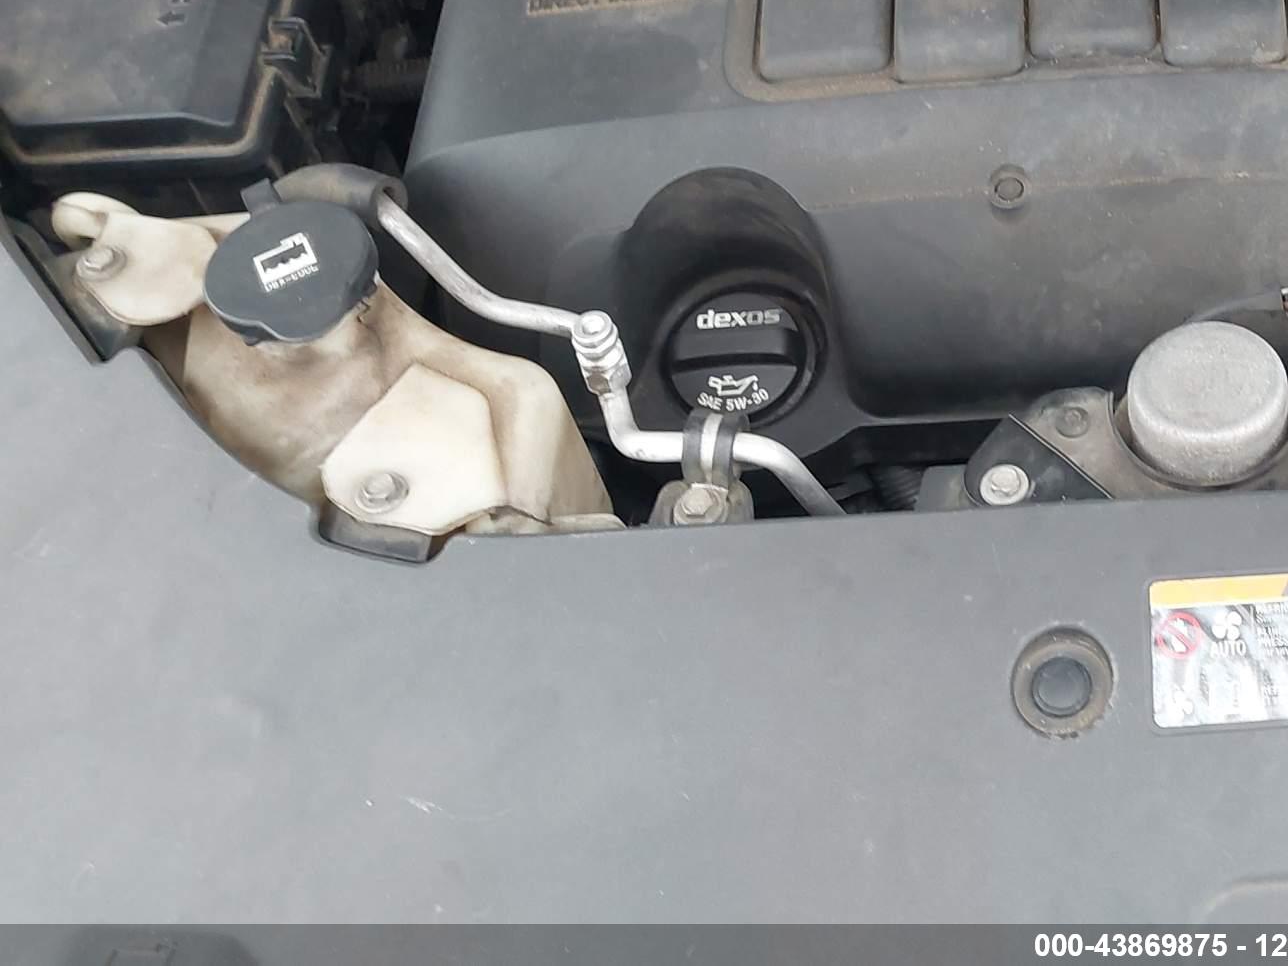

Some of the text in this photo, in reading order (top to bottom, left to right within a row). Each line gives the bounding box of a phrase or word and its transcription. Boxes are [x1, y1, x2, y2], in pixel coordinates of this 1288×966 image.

[696, 308, 780, 330] dexos
[697, 388, 769, 412] SAE 5W-30
